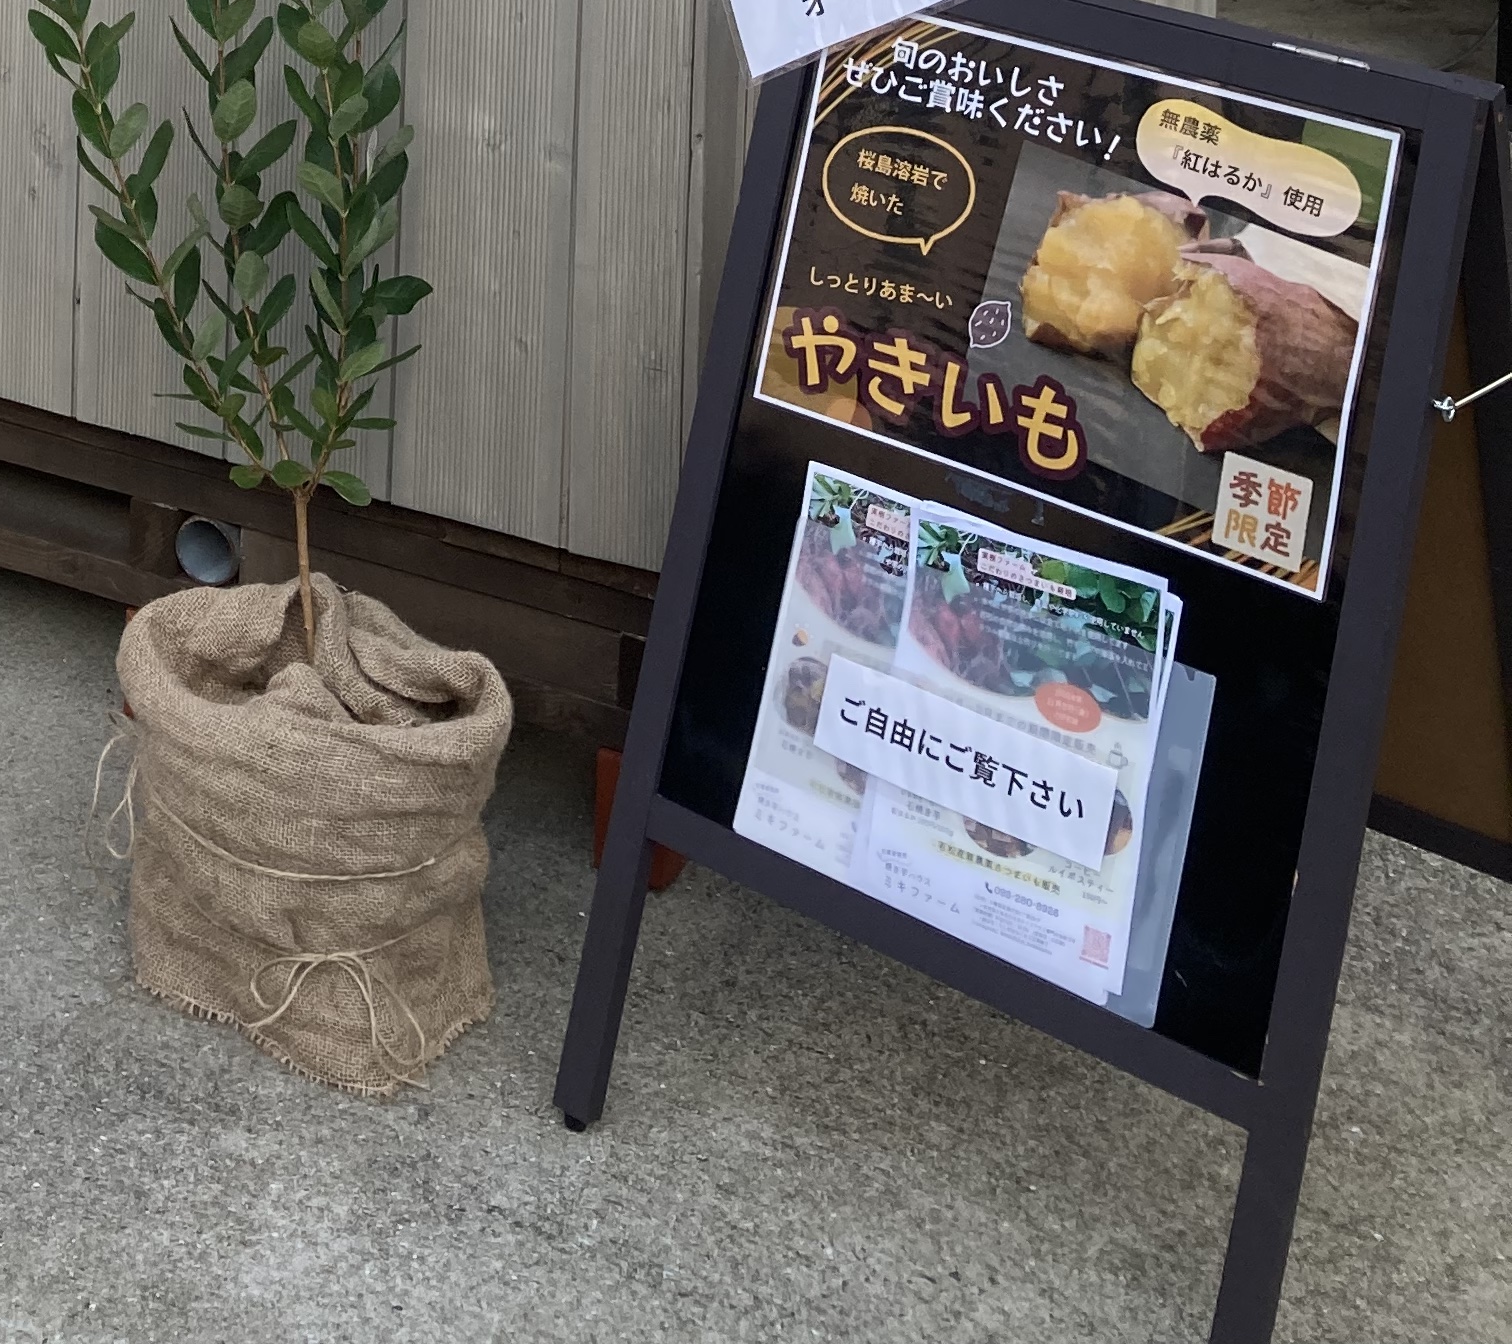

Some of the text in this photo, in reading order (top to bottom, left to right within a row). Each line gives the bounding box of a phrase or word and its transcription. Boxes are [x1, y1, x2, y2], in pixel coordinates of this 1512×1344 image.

[891, 37, 1065, 105] 旬のおいしさ
[1159, 108, 1221, 146] 無農薬
[857, 148, 949, 190] 桜島溶岩で
[850, 183, 904, 215] 焼いた
[791, 314, 1079, 471] やきいも
[1230, 469, 1301, 514] 季節
[1224, 509, 1293, 559] 限定
[839, 696, 1085, 820] ご自由にご覧下さい
